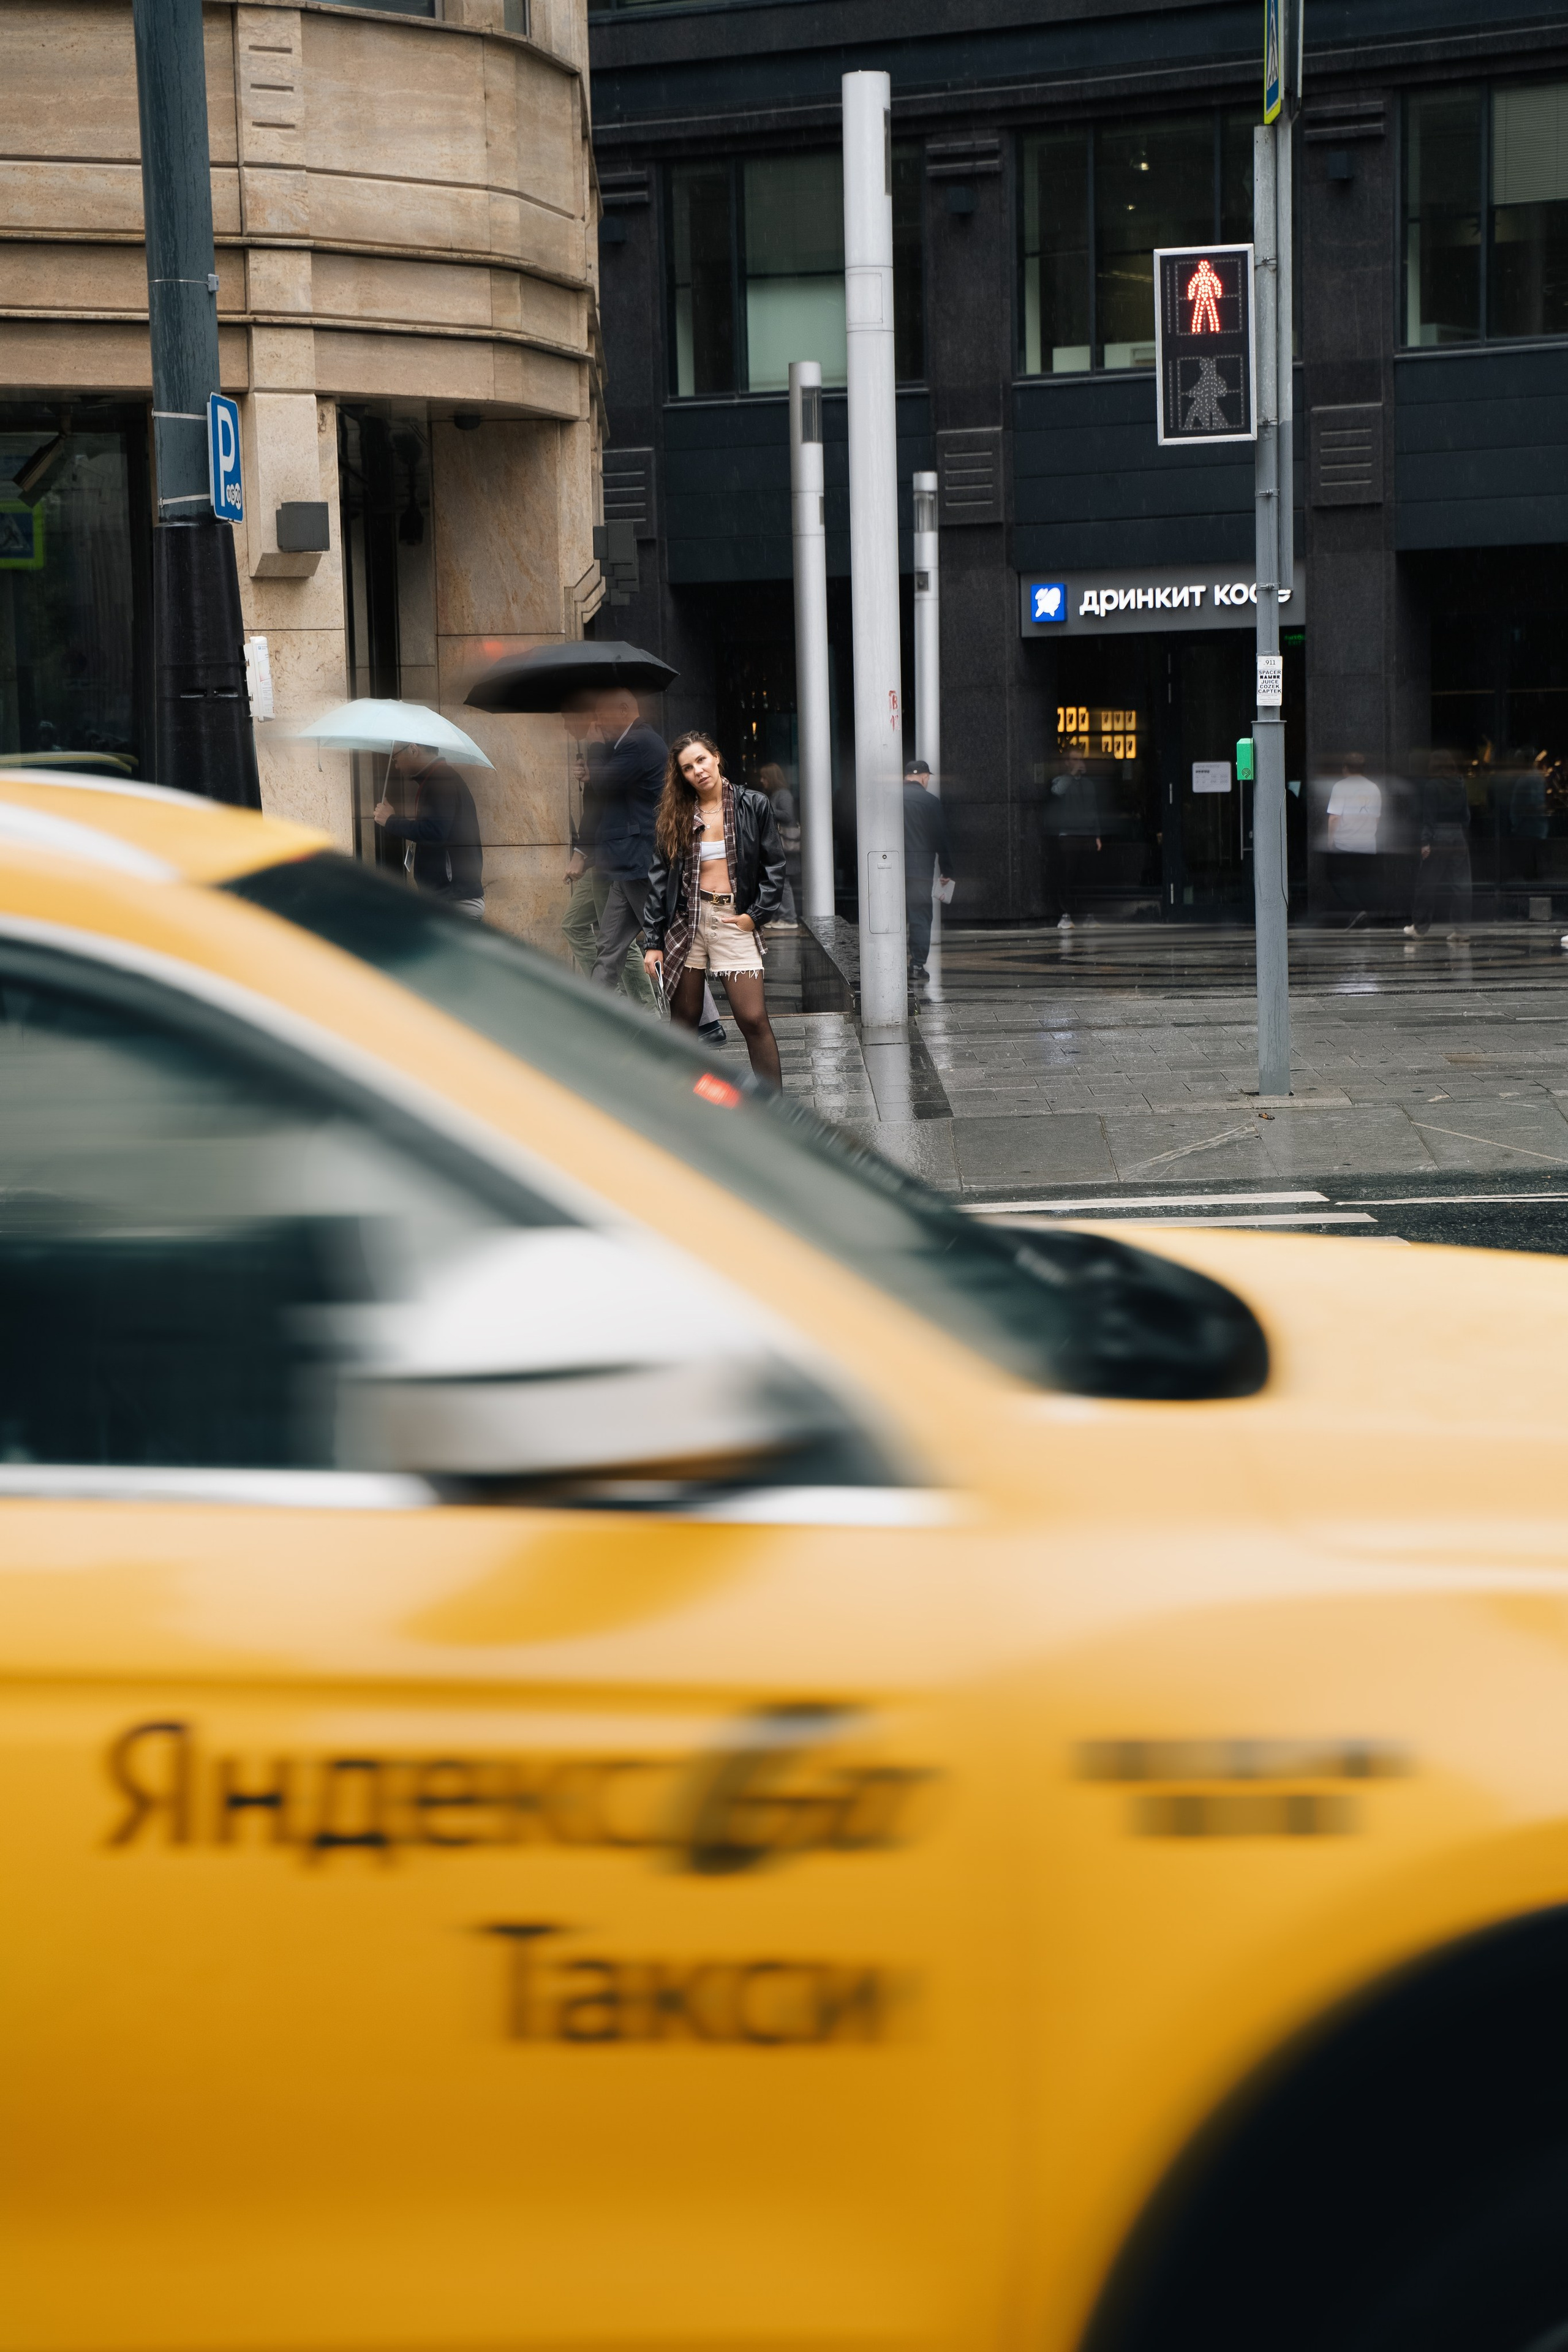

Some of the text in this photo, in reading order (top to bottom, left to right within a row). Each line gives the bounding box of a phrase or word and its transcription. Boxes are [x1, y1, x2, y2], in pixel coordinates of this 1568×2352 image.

[217, 404, 236, 508] P
[235, 488, 241, 504] 20
[1079, 585, 1206, 617] дринкит
[103, 1720, 689, 1871] Яндекс
[463, 1918, 913, 2046] Такси
